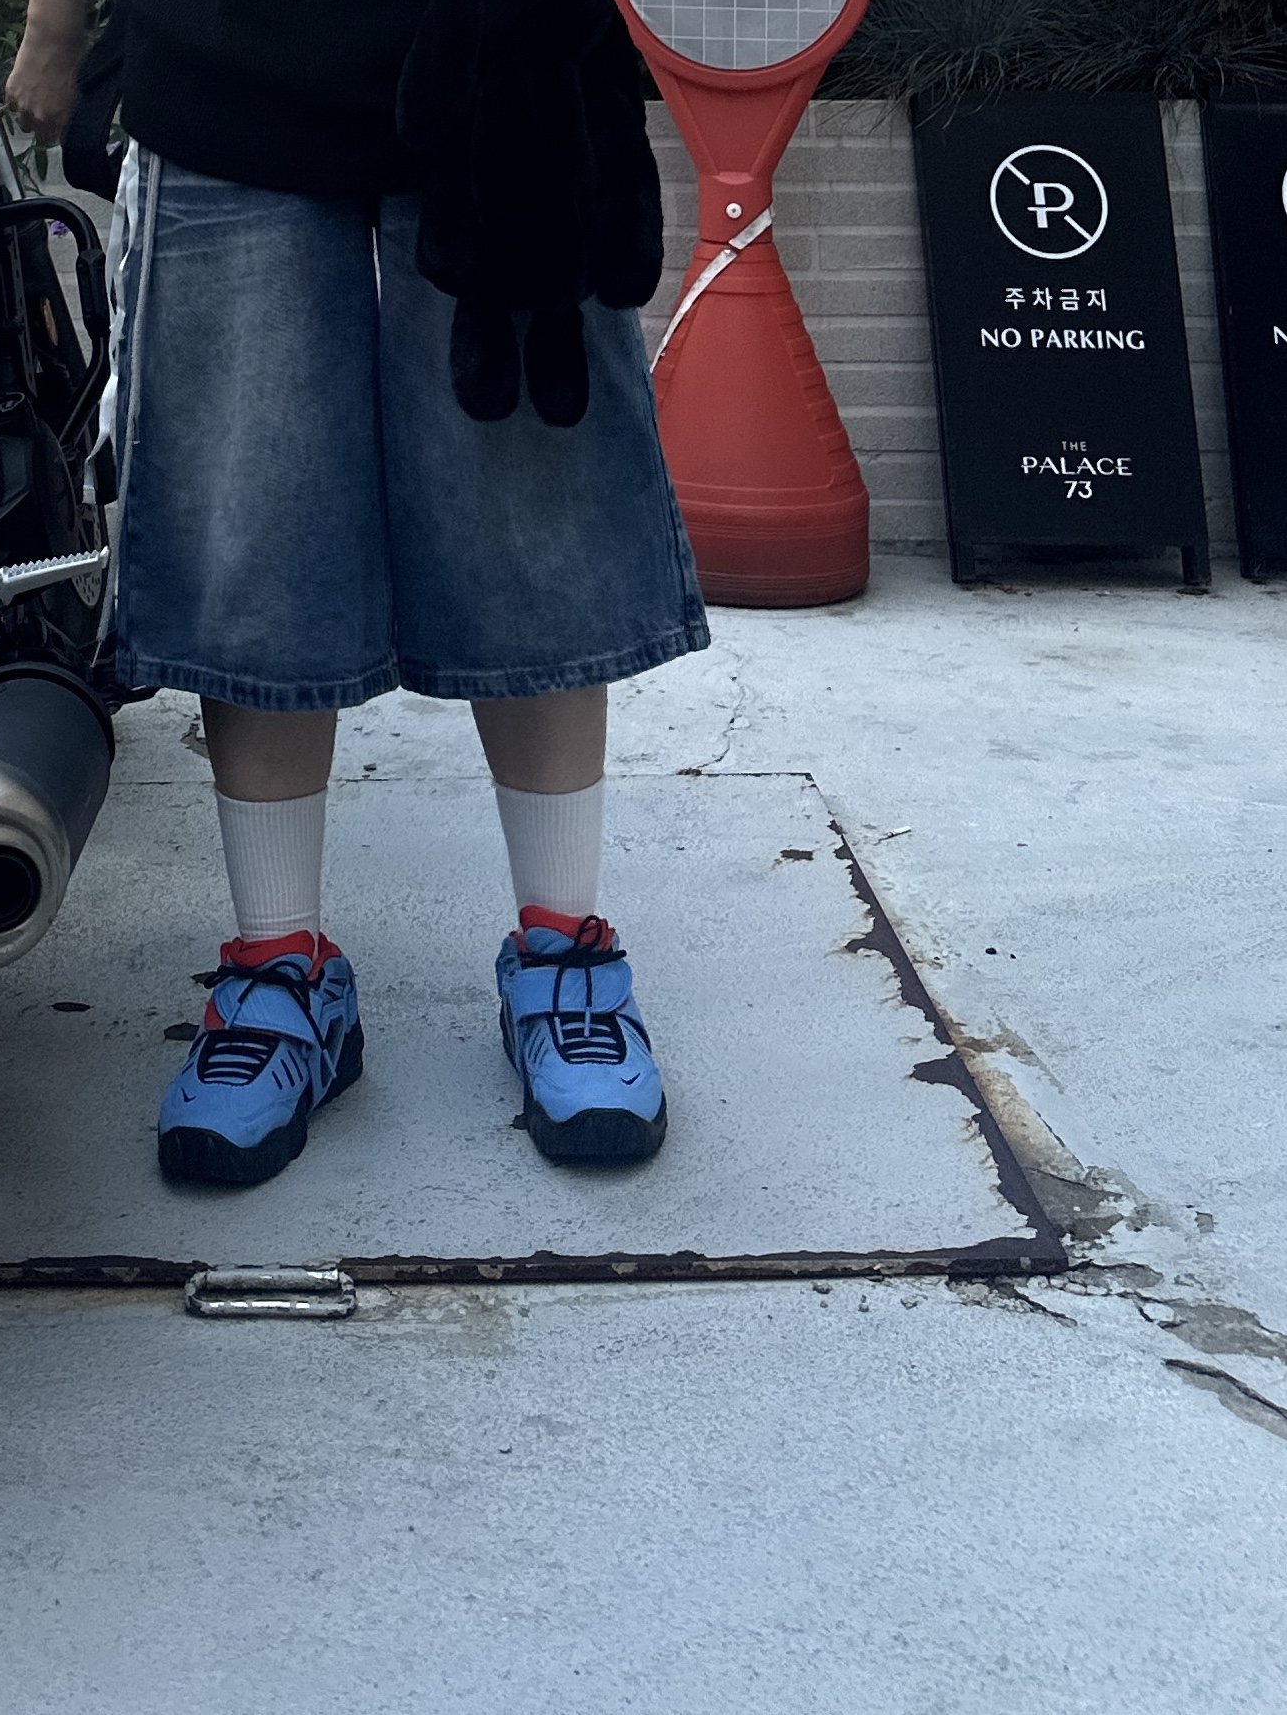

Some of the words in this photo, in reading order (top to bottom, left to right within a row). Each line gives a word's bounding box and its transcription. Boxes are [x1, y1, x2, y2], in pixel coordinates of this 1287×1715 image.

[1004, 287, 1108, 312] 주차금지
[980, 328, 1022, 349] NO
[1030, 328, 1146, 351] PARKING
[1061, 440, 1088, 452] THE
[1021, 456, 1133, 476] PALACE
[1063, 480, 1093, 499] 73
